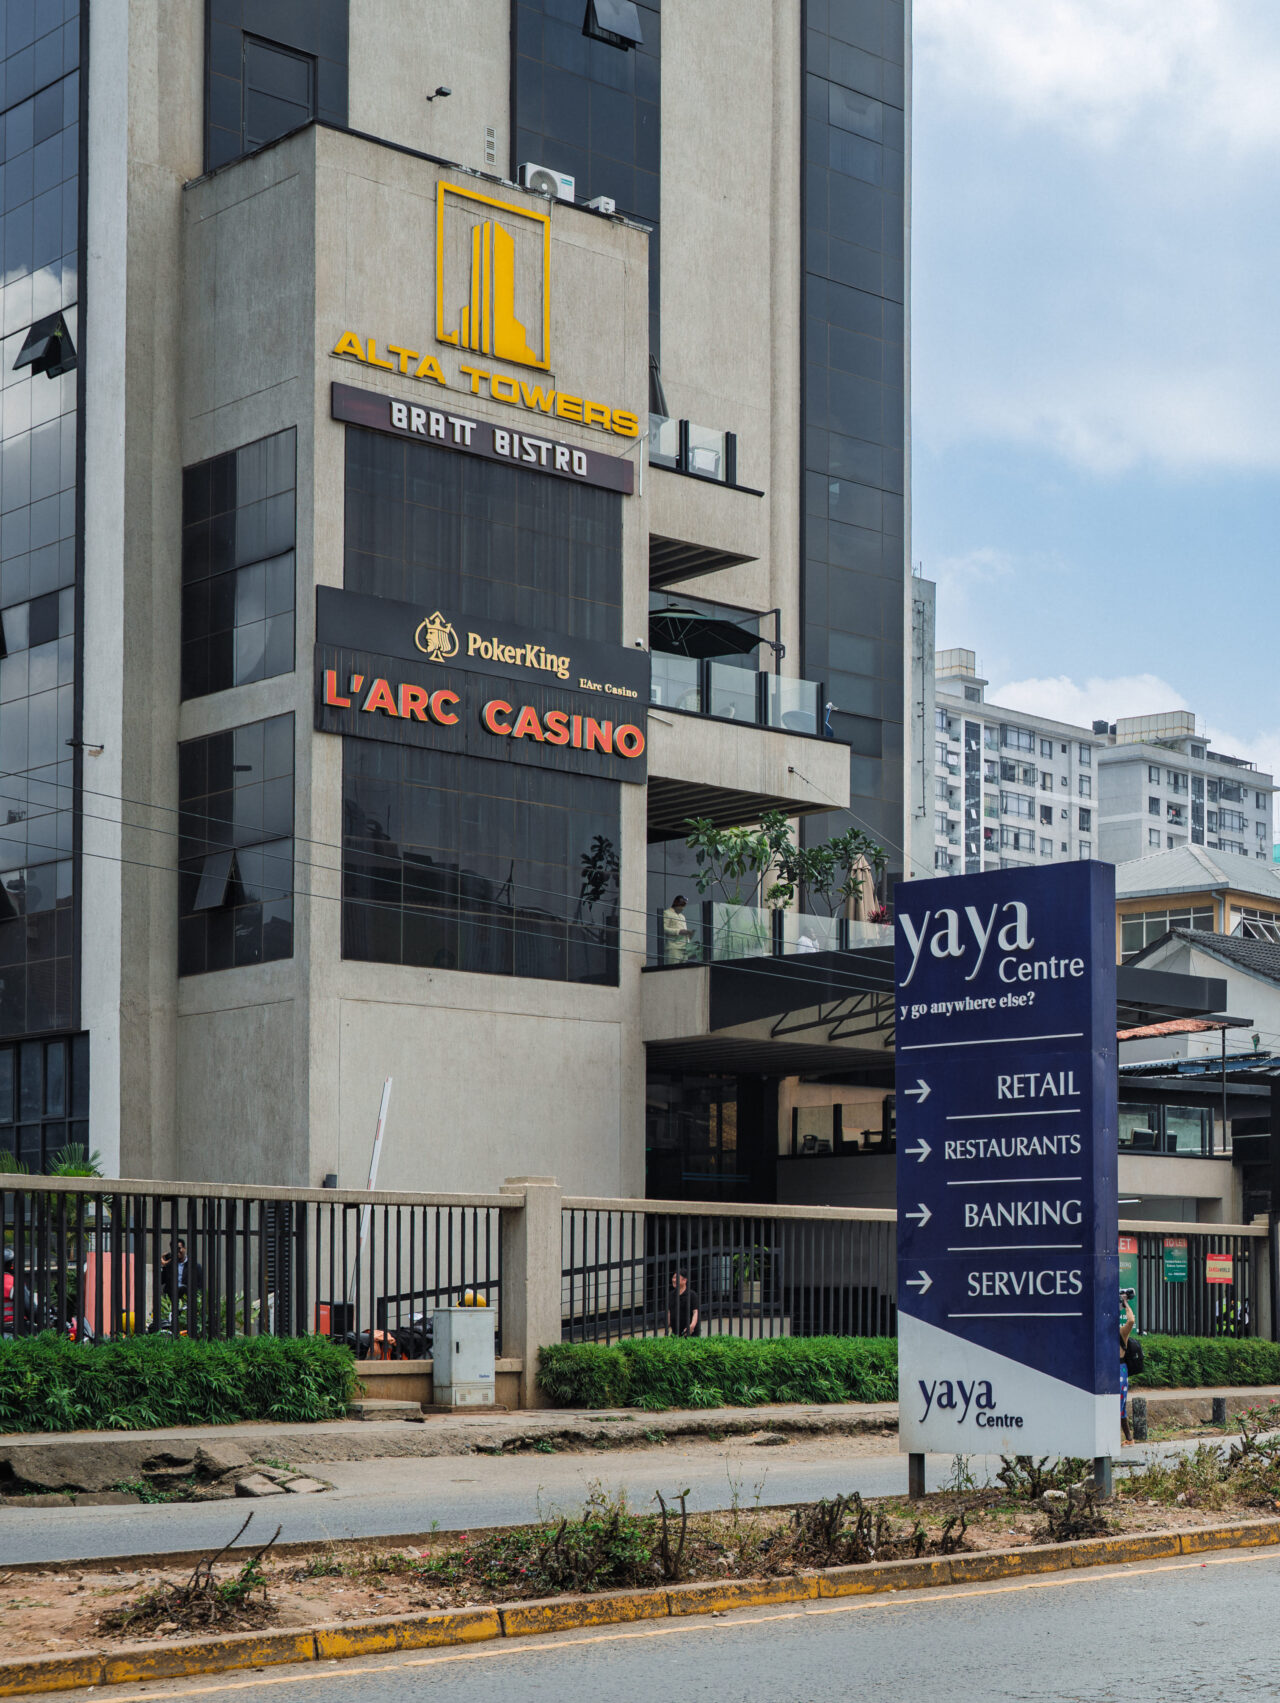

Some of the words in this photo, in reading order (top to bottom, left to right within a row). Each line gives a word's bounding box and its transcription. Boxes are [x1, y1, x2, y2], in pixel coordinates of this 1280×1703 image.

[332, 330, 447, 385] ALTA
[459, 364, 640, 438] TOWERS
[390, 401, 477, 446] BRATT
[494, 428, 588, 477] BISTRO
[467, 632, 571, 680] PokerKing
[579, 678, 602, 692] L'Arc
[604, 684, 638, 698] Casino
[322, 669, 461, 726] L'ARC
[481, 700, 646, 759] CASINO
[898, 901, 1035, 988] yaya
[998, 956, 1085, 984] Centre
[911, 1002, 928, 1019] go
[930, 996, 997, 1016] anywhere
[999, 991, 1036, 1008] else?
[997, 1071, 1081, 1100] RETAIL
[944, 1134, 1082, 1160] RESTAURANTS
[964, 1200, 1083, 1227] BANKING
[1118, 1237, 1132, 1250] ET
[967, 1270, 1083, 1297] SERVICES
[918, 1379, 997, 1424] yaya
[975, 1411, 1024, 1428] Centre
